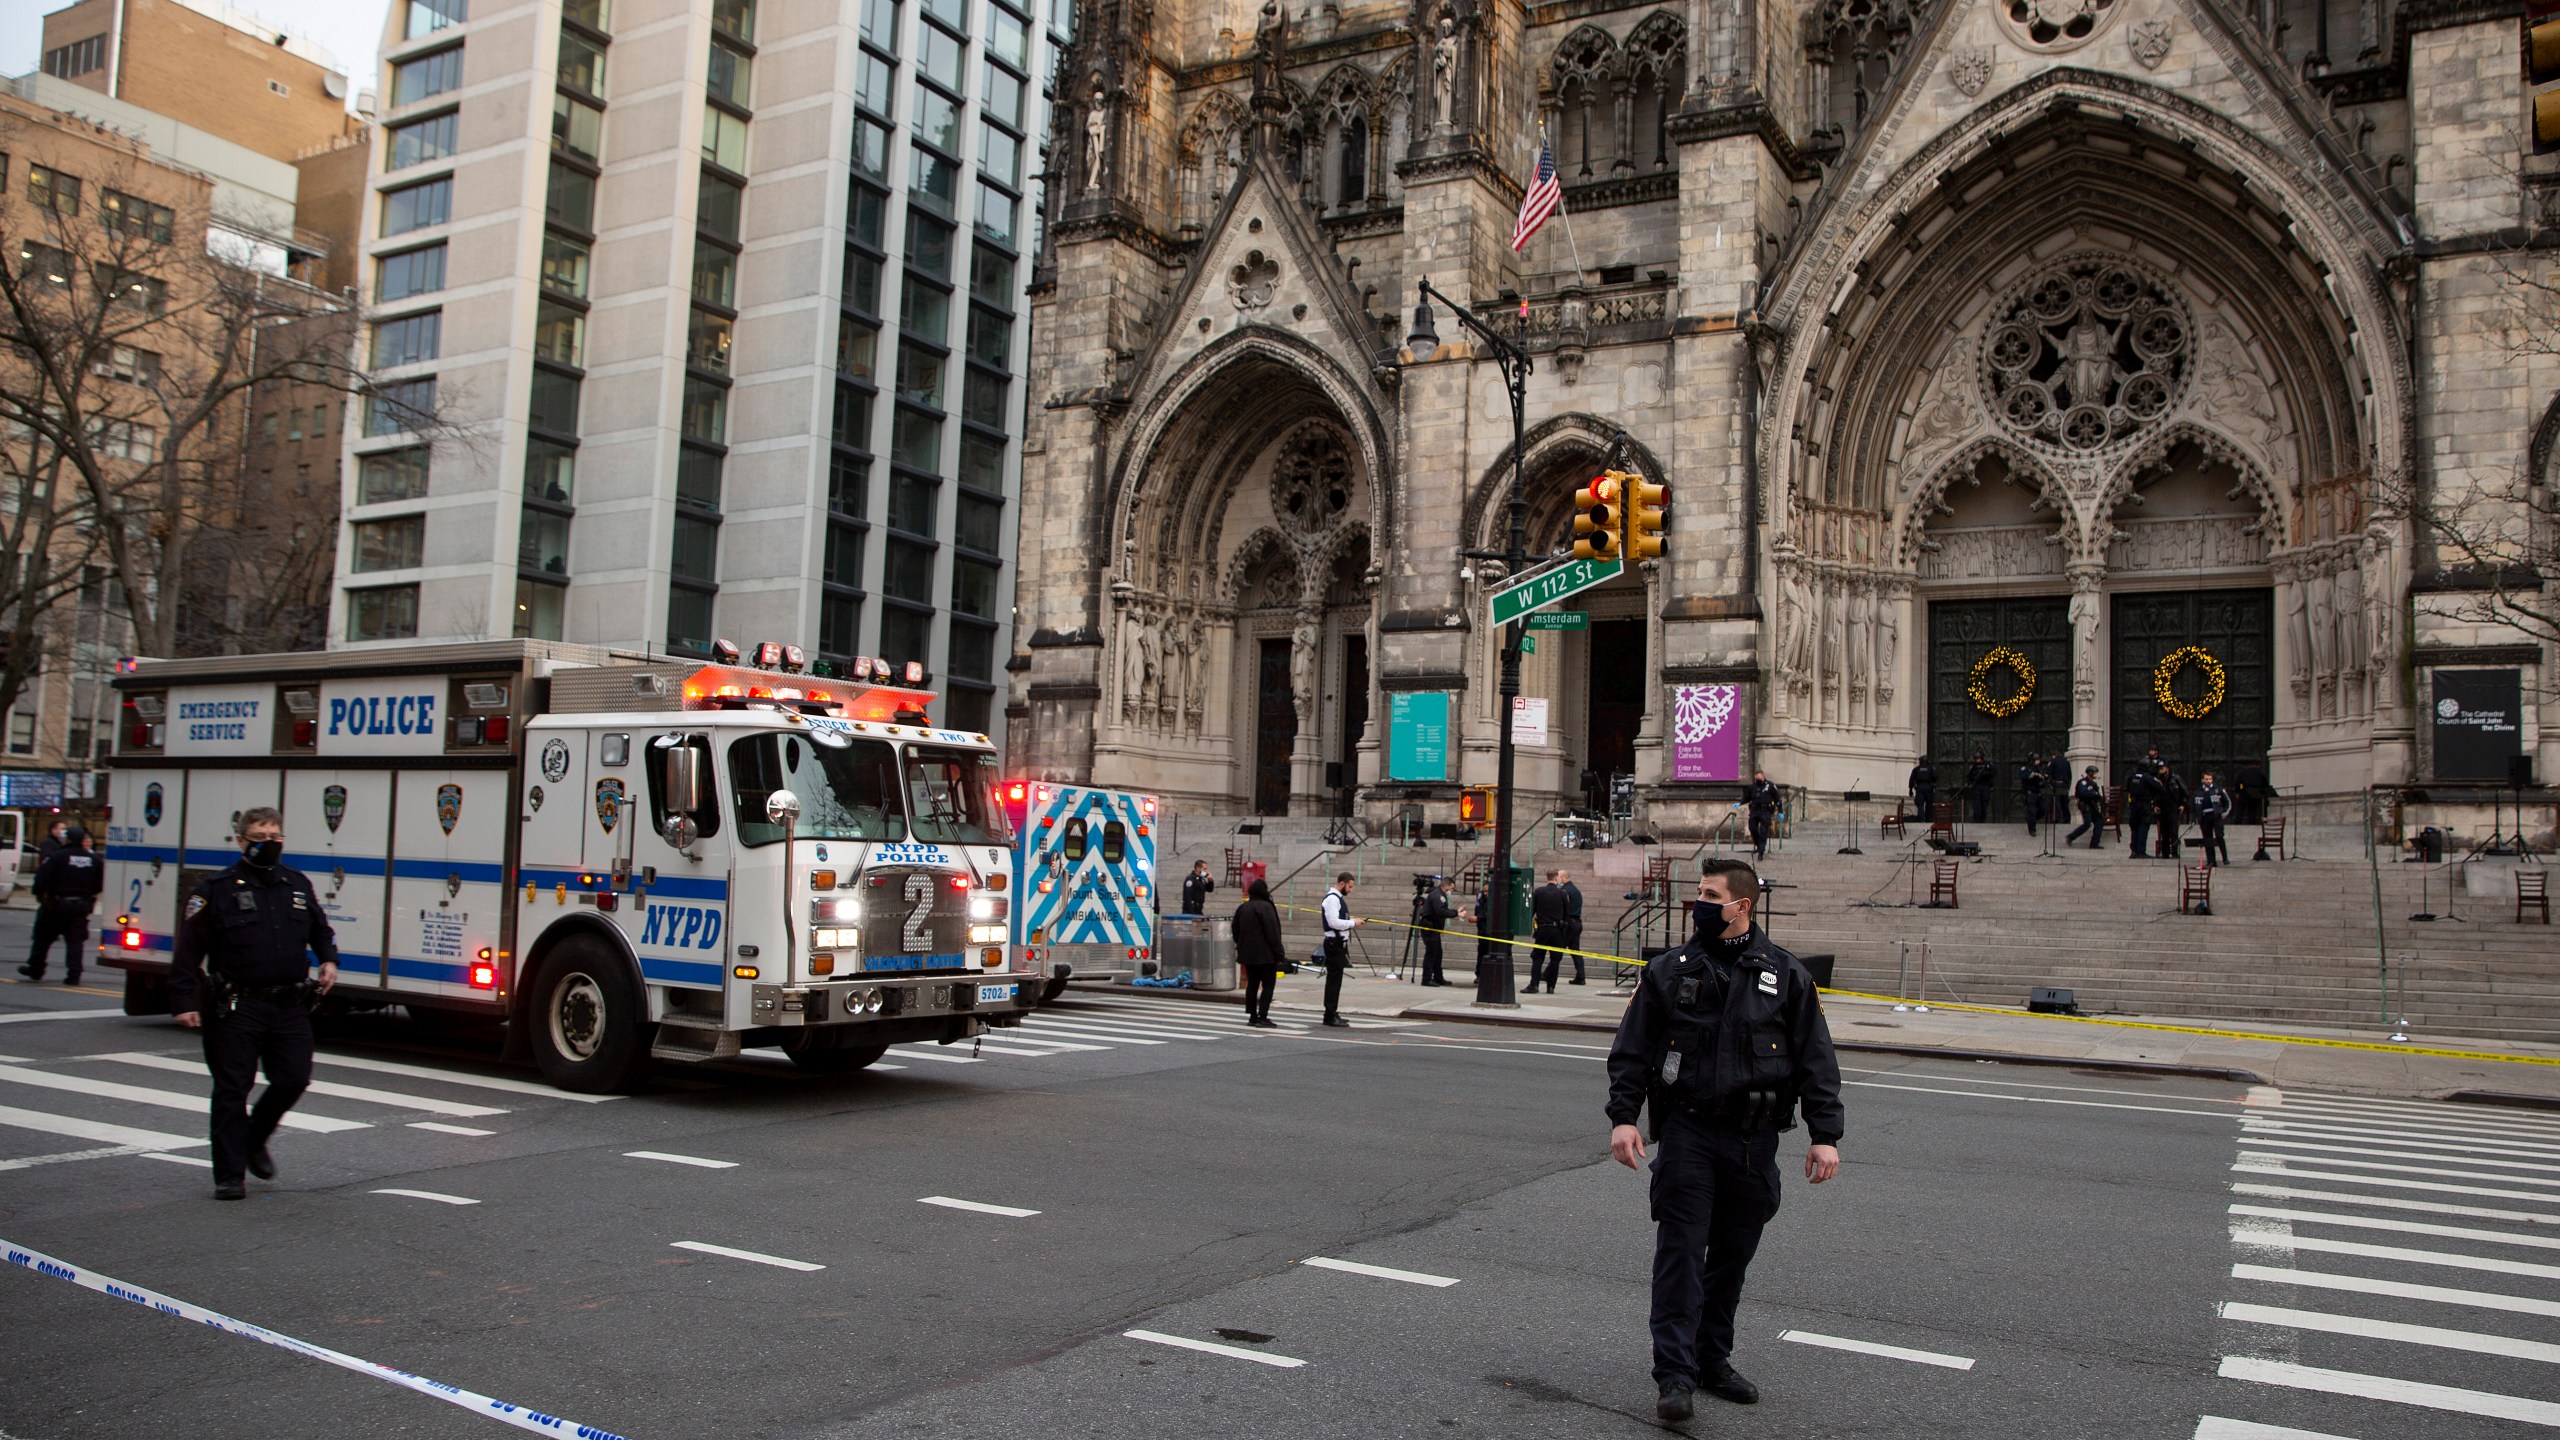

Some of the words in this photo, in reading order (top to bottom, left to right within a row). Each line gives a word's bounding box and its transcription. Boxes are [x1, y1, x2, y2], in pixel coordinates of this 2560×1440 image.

[1518, 586, 1533, 608] W
[1541, 573, 1568, 598] 112
[1575, 561, 1593, 584] St
[179, 700, 259, 720] EMERGENCY
[329, 694, 435, 737] POLICE
[189, 723, 246, 742] SERVICE
[939, 732, 966, 743] TWO
[884, 843, 939, 853] NYPD
[875, 853, 949, 864] POLICE
[129, 878, 143, 913] 2
[1098, 887, 1120, 900] Sinai
[903, 874, 934, 952] 2
[1065, 910, 1119, 922] AMBULANCE
[641, 903, 722, 950] NYPD
[1724, 933, 1750, 945] NYPD
[864, 956, 923, 971] EMERGENCY
[926, 953, 965, 968] SERVICE
[981, 988, 1003, 1001] 5702
